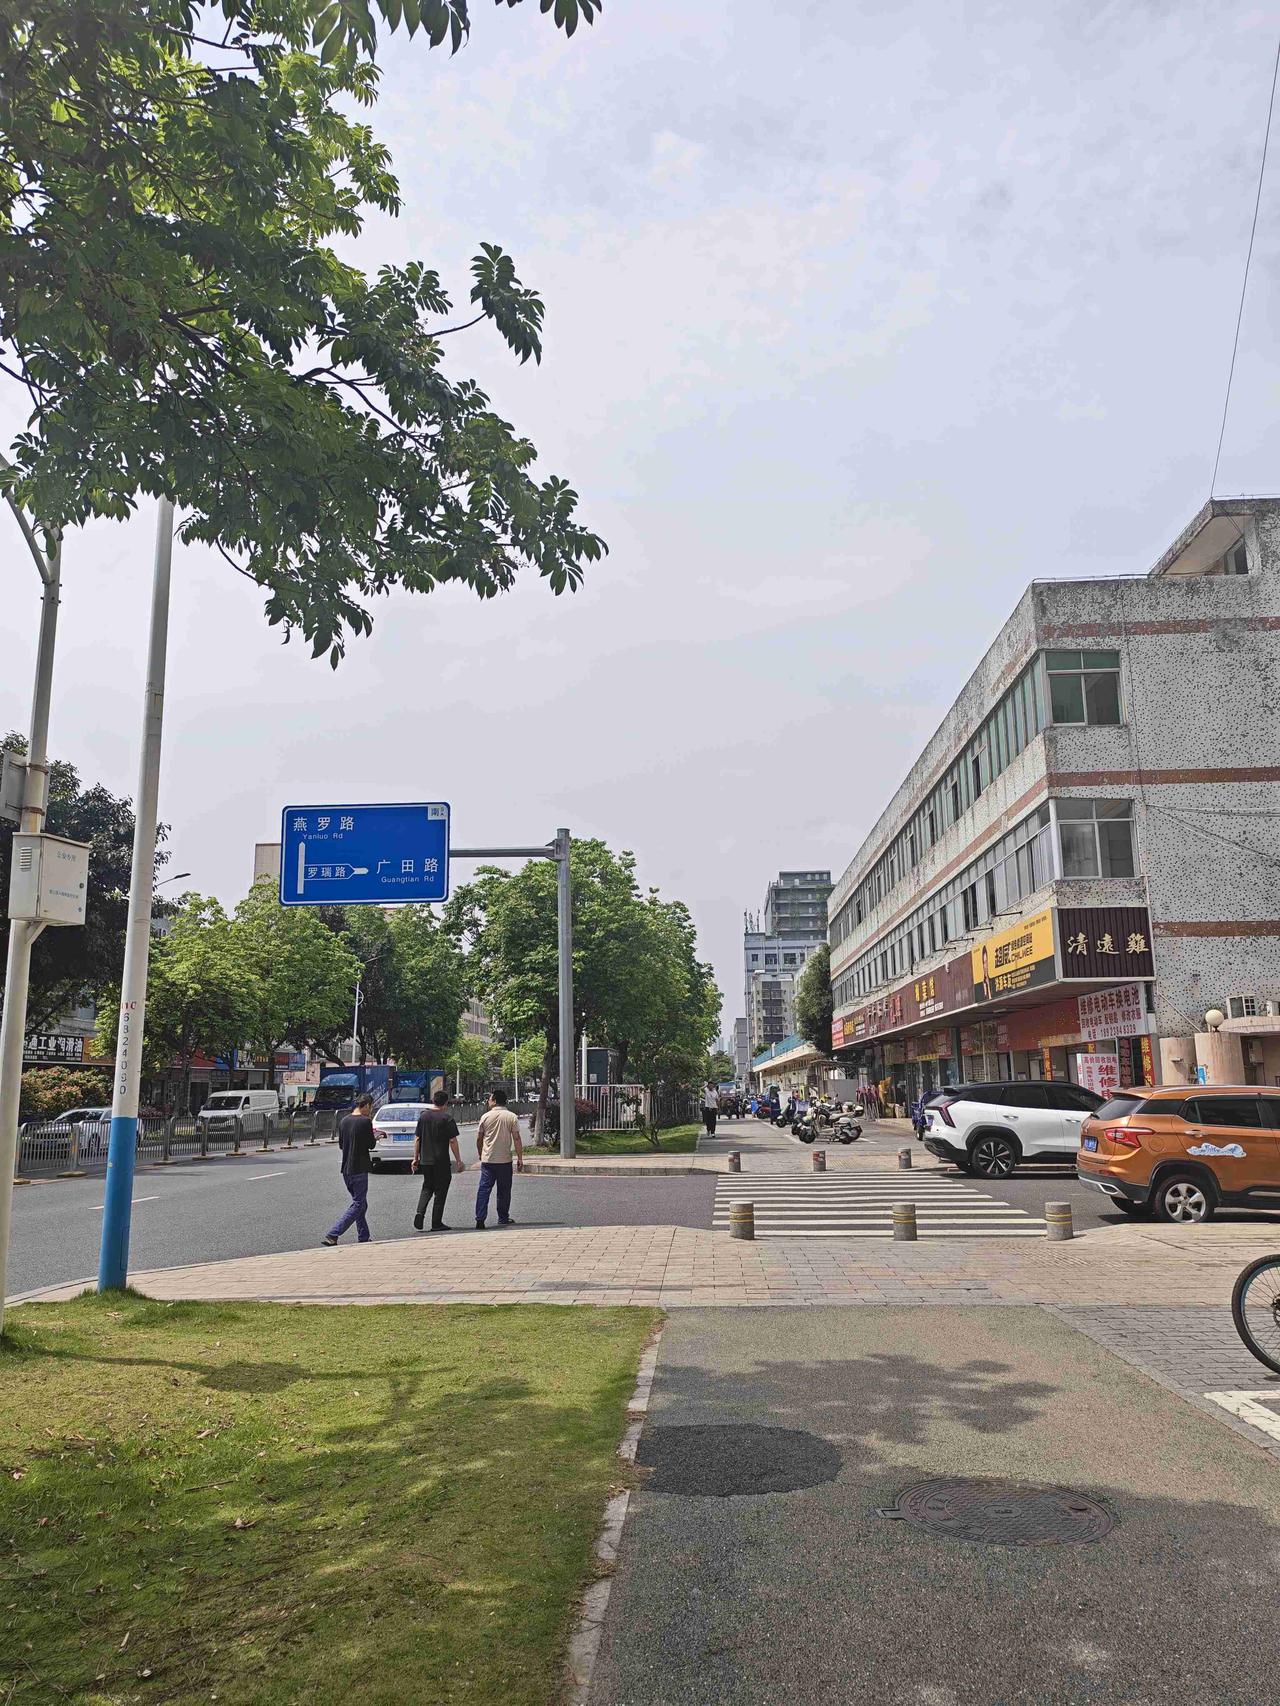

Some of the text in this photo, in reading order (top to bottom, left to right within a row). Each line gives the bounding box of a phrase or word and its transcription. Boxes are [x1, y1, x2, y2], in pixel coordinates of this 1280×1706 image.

[293, 816, 355, 832] 燕罗路
[303, 832, 328, 840] Yanluo
[307, 866, 346, 879] 罗瑞路
[376, 858, 439, 874] 广田路
[381, 876, 419, 884] Guangtian
[1080, 984, 1140, 1016] 维修电动车换电池
